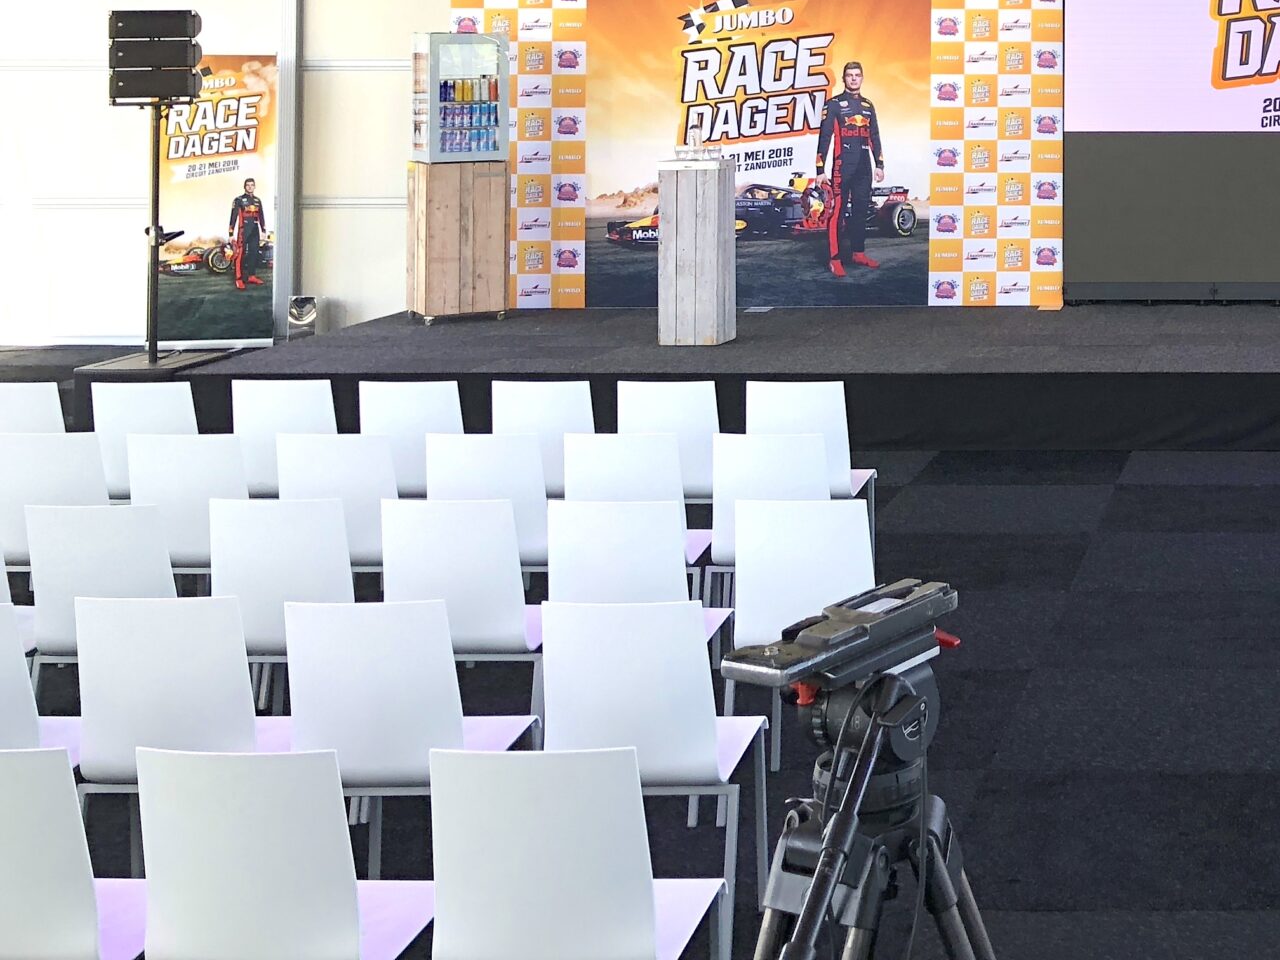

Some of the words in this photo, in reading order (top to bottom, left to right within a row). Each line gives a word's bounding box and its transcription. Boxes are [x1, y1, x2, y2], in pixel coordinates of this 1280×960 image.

[713, 7, 795, 34] JUMBO
[681, 32, 835, 104] RACE
[201, 77, 236, 91] MBO
[166, 94, 262, 137] RACE
[683, 89, 828, 146] DAGEN
[167, 126, 258, 161] DAGEN
[744, 149, 765, 162] MEI
[768, 146, 794, 159] 2018
[744, 158, 794, 172] ZANDVOORT
[632, 229, 659, 240] Mobi
